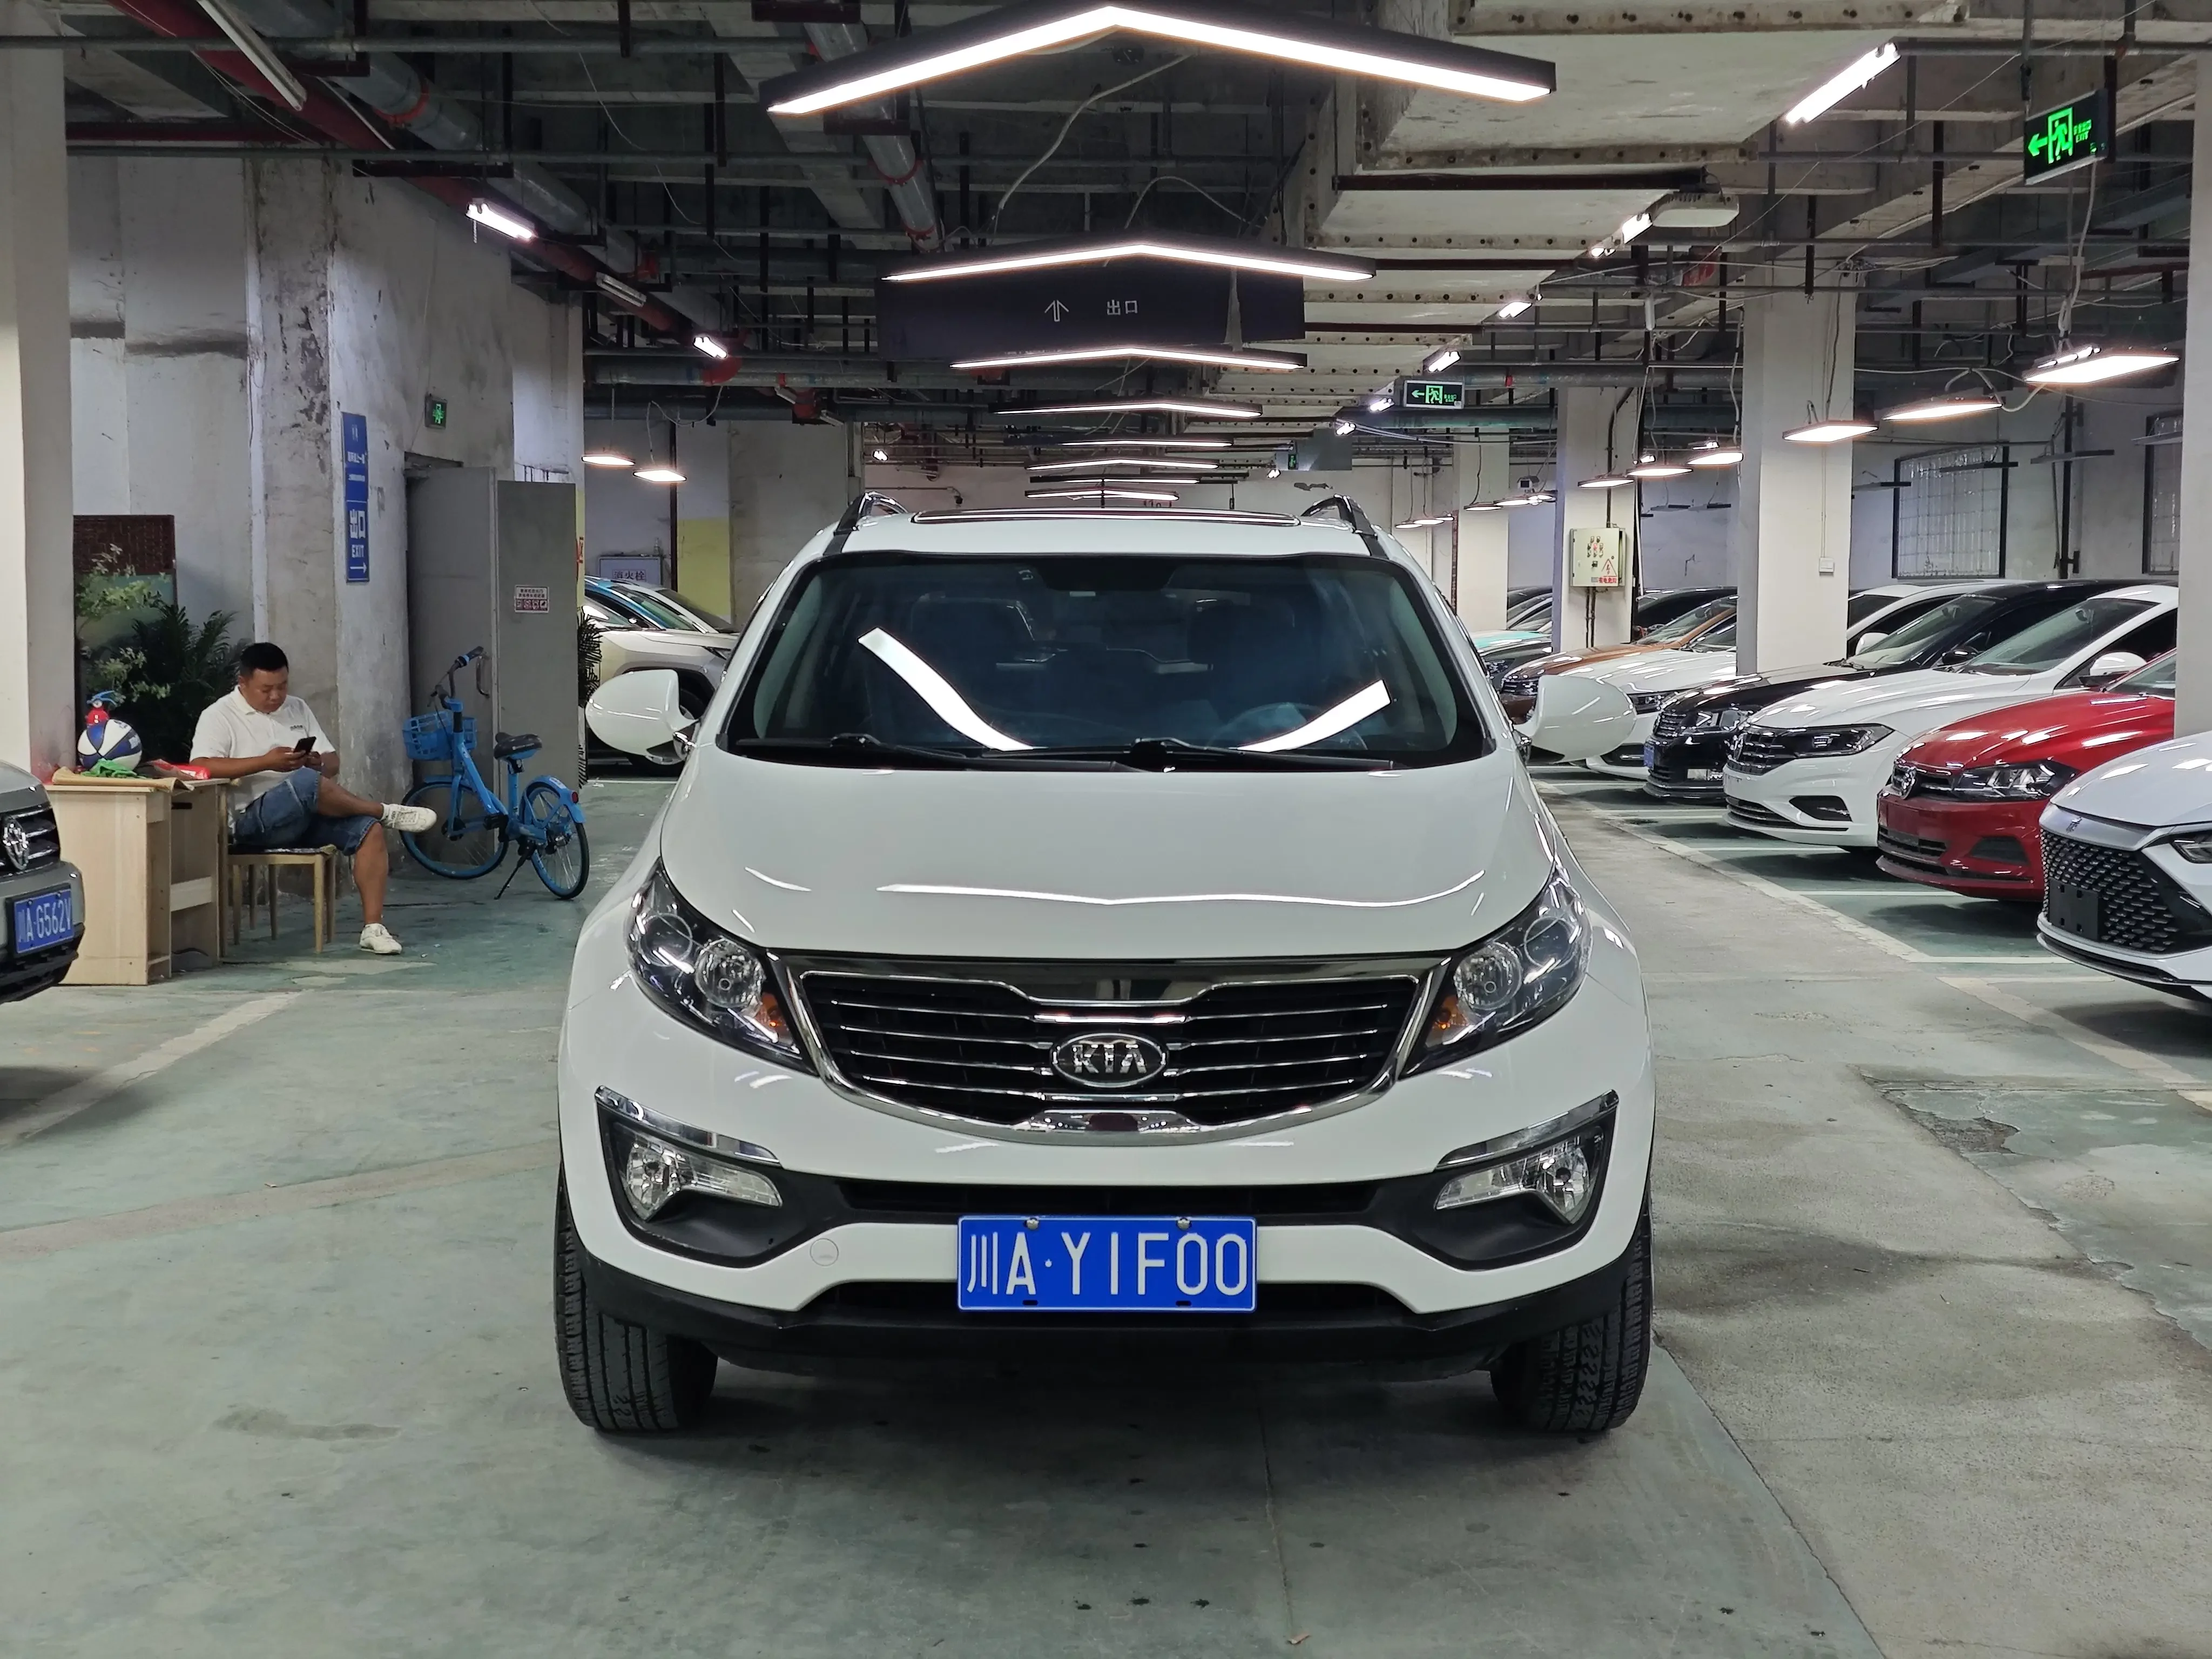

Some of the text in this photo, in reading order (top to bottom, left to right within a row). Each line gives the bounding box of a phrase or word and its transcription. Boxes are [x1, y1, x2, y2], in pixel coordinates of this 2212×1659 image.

[1107, 299, 1138, 315] 出口
[349, 508, 366, 538] 出口
[352, 544, 365, 558] EXIT
[614, 570, 645, 581] 消火栓
[1071, 1044, 1147, 1074] KIA
